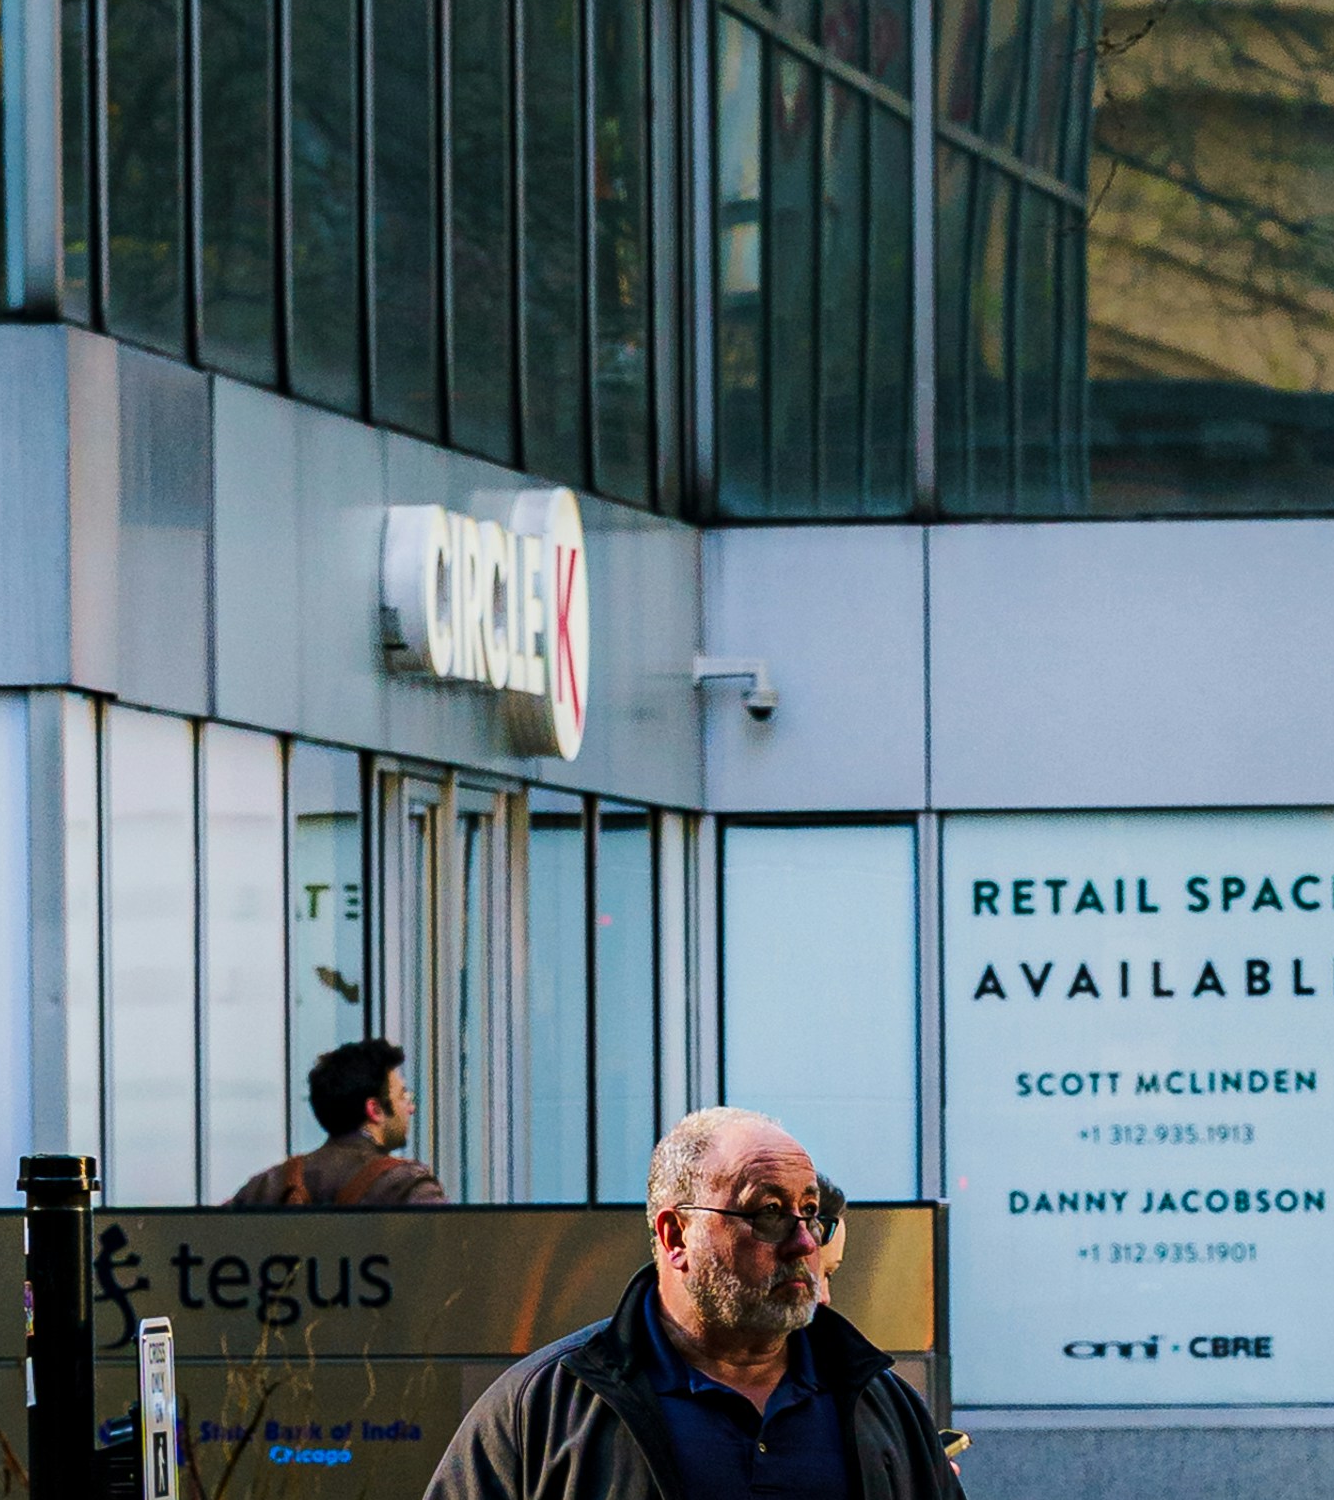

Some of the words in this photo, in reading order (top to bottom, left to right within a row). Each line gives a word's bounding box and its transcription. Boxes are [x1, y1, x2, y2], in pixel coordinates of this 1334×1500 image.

[425, 506, 545, 696] CIRCLE
[555, 545, 583, 736] K
[972, 878, 1159, 915] RETAIL
[1016, 1071, 1119, 1097] SCOTT
[1134, 1068, 1318, 1096] MCLINDEN
[1009, 1190, 1127, 1214] DANNY
[1142, 1190, 1326, 1214] JACOBSON
[171, 1243, 393, 1327] tegus
[1188, 1336, 1273, 1359] CBRE
[362, 1420, 421, 1442] India
